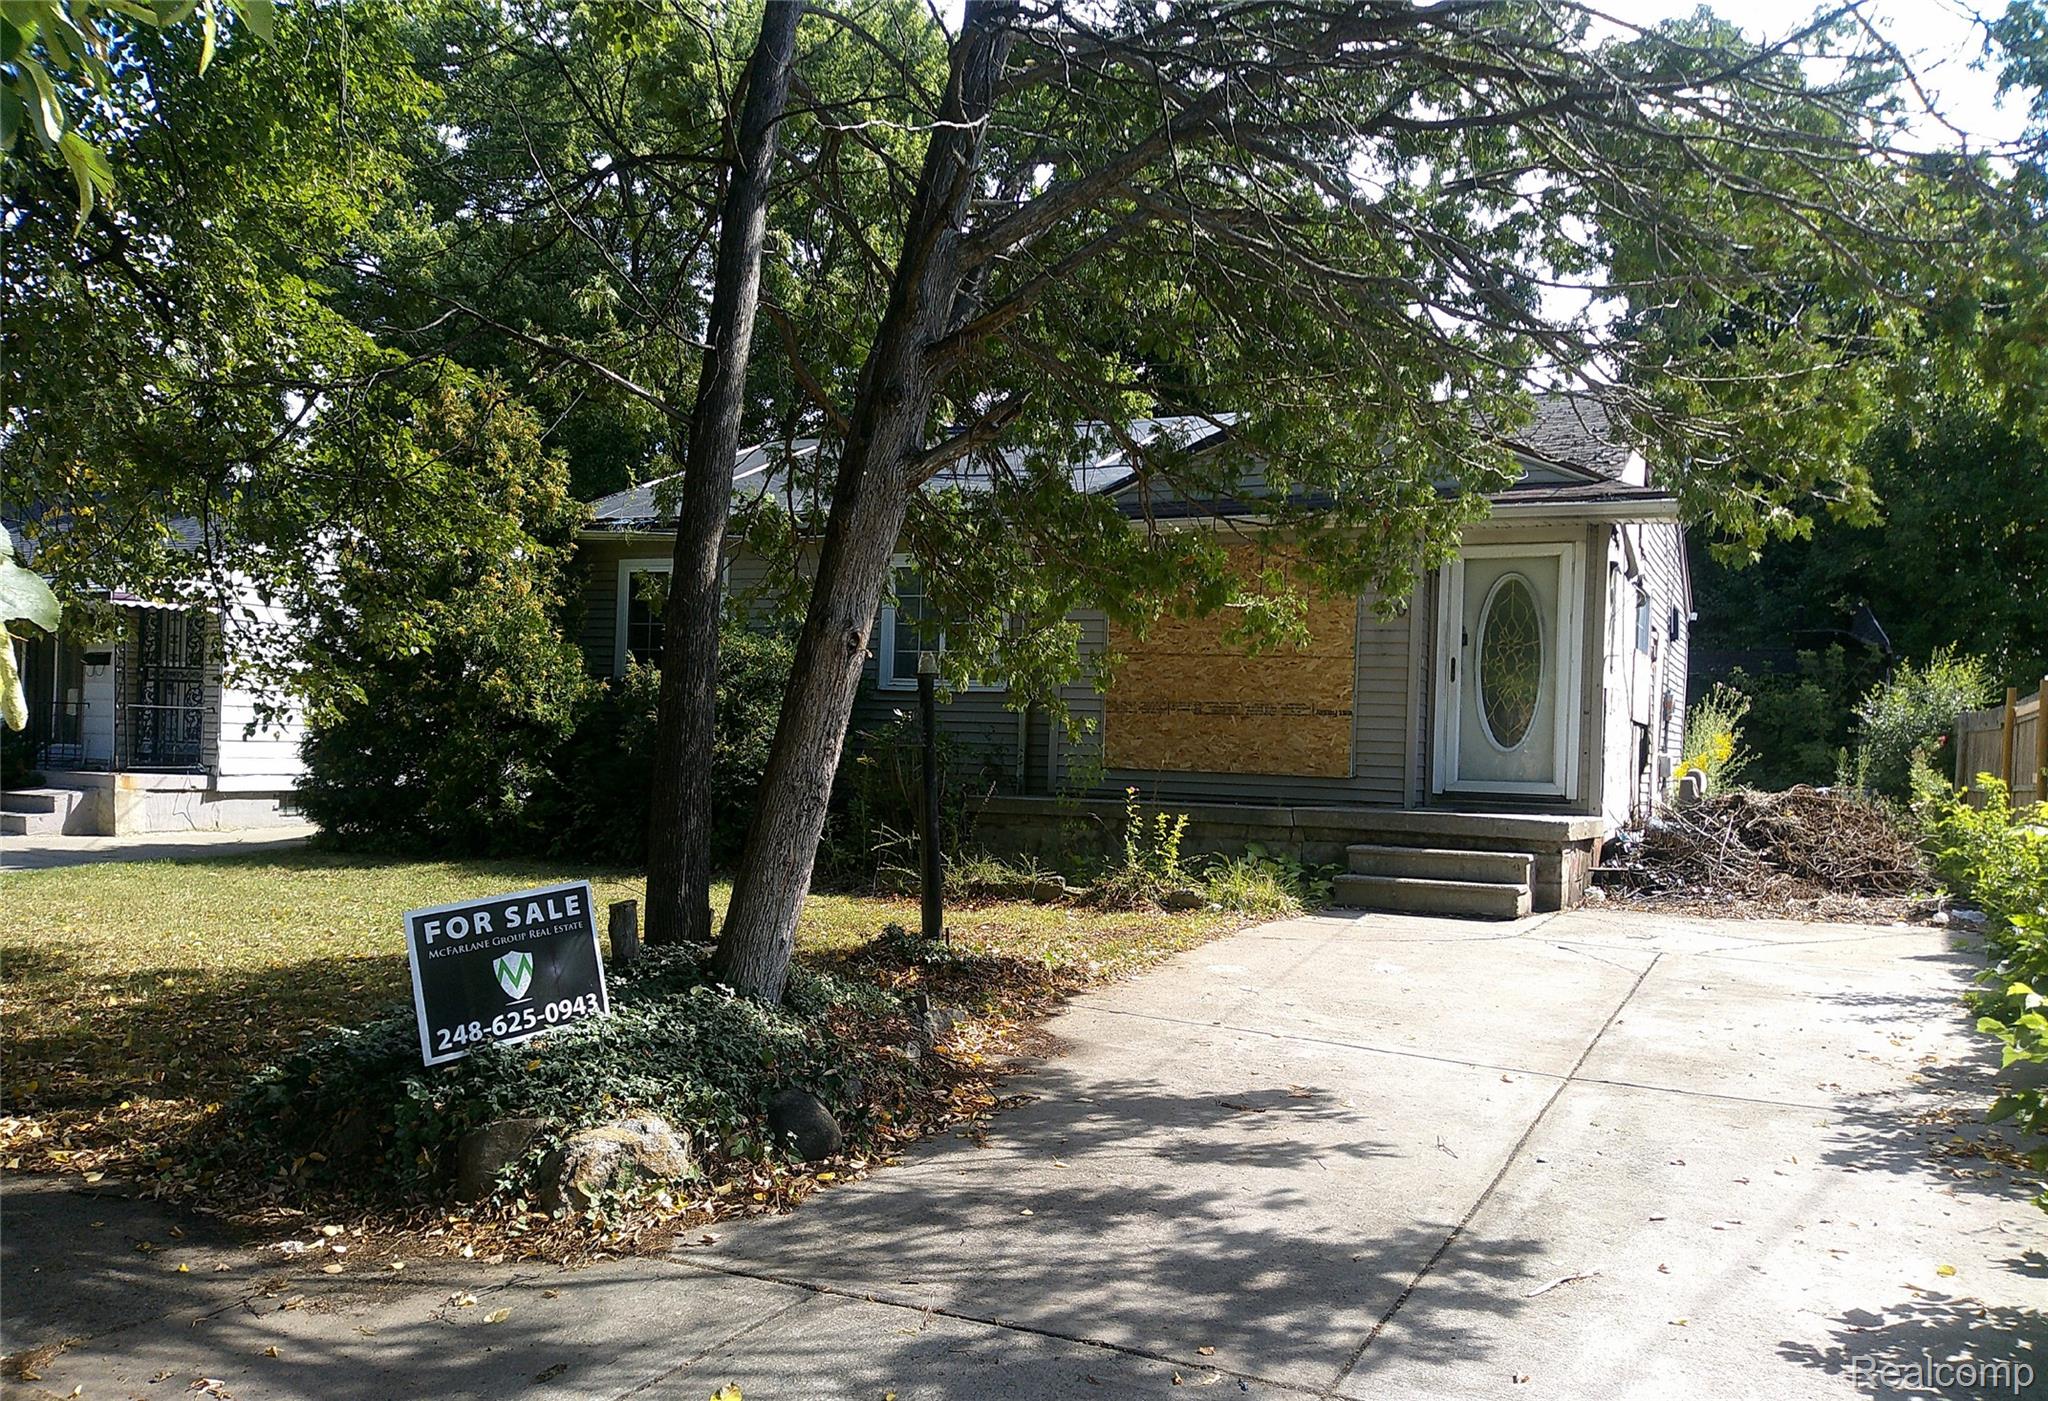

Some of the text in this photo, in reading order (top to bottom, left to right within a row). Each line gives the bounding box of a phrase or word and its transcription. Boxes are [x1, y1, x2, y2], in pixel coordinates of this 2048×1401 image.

[424, 894, 581, 945] FOR SALE
[437, 992, 599, 1051] 248-625-0943
